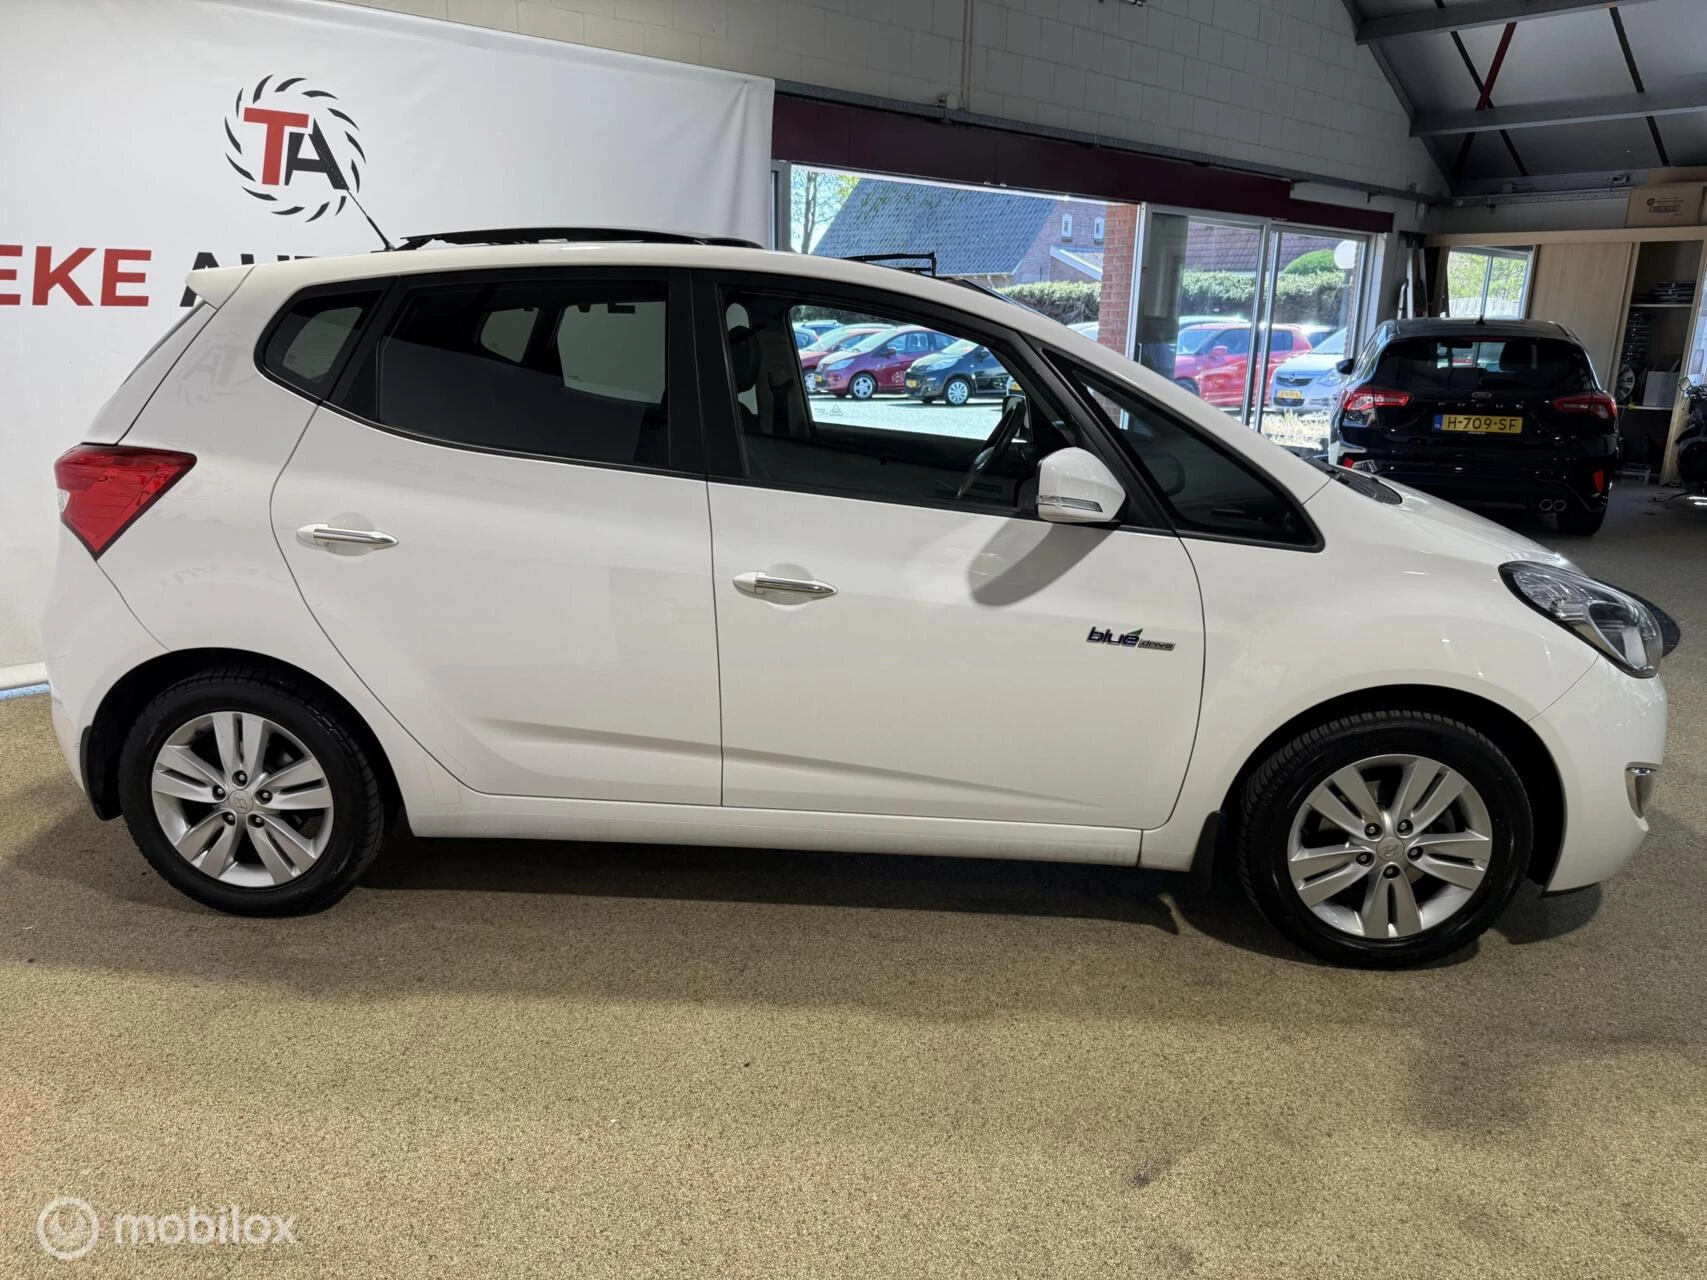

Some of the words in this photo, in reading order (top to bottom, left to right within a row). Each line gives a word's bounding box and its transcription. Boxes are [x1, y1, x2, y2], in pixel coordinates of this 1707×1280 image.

[243, 106, 350, 191] TA
[1447, 416, 1517, 432] H-709-SF
[1086, 626, 1141, 648] blue
